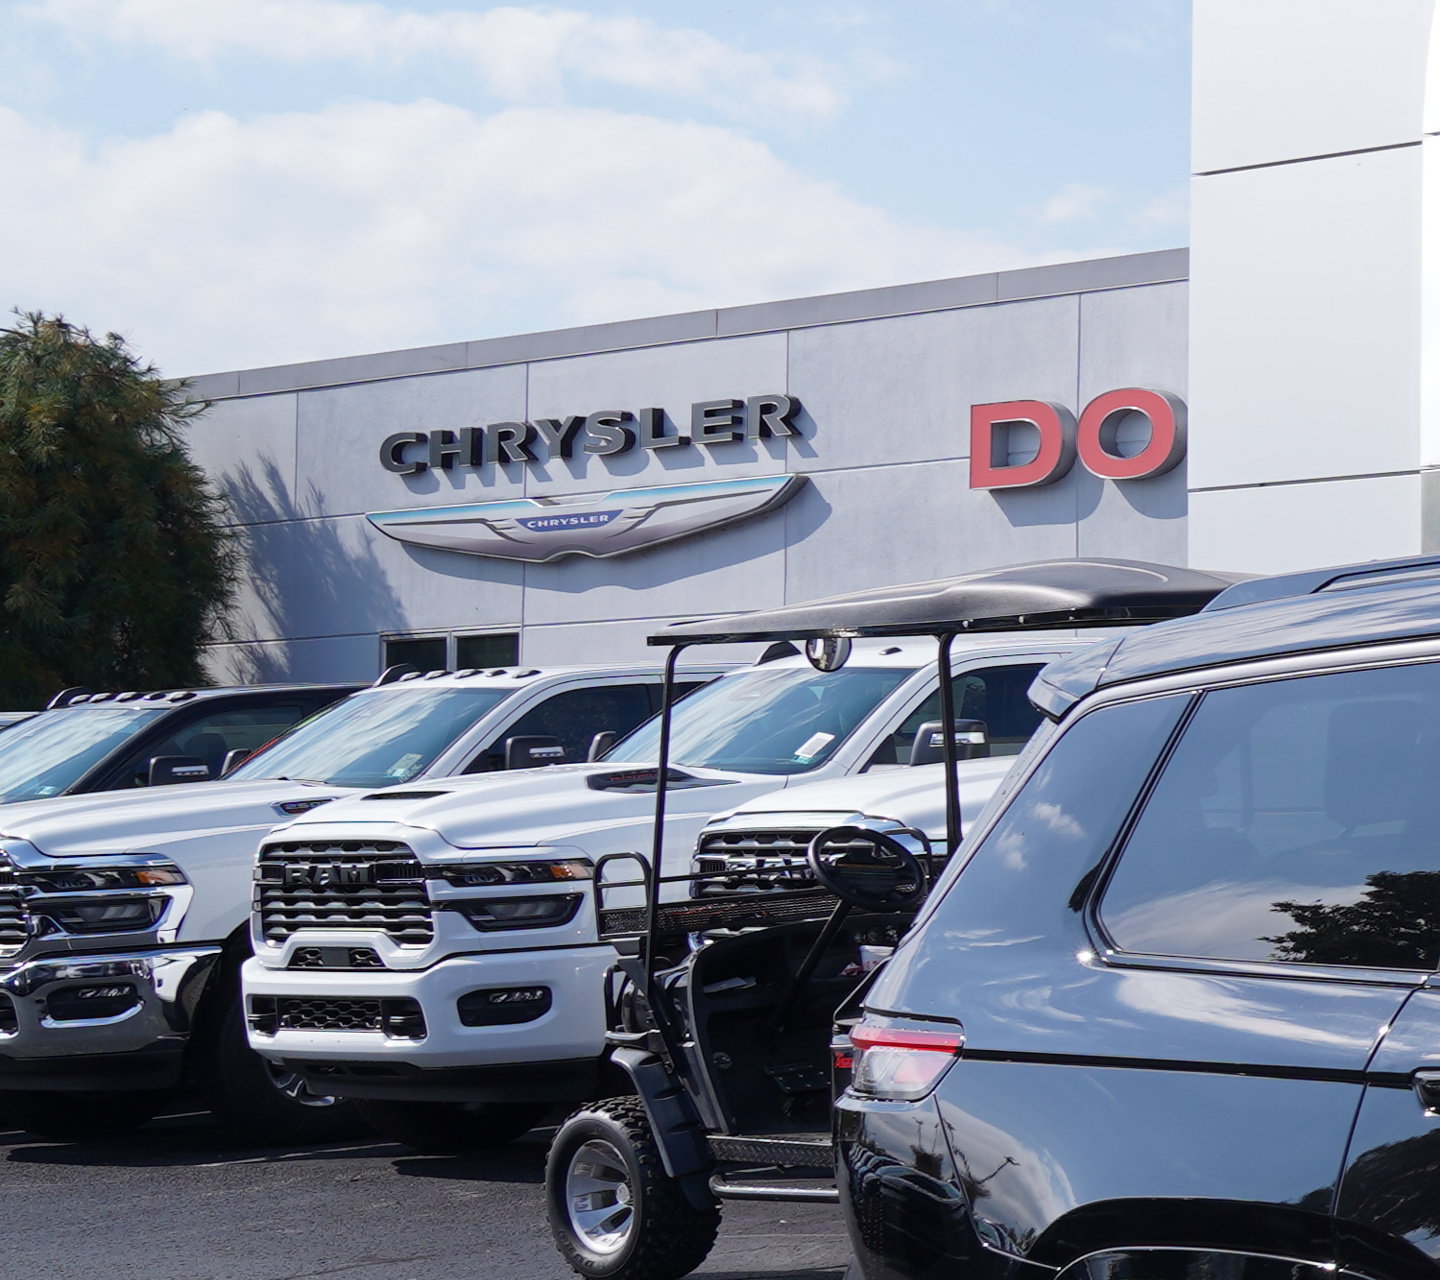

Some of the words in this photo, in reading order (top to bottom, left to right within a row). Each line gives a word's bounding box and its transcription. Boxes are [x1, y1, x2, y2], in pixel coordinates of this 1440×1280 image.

[379, 392, 803, 476] CHRYSLER
[526, 513, 611, 529] CHRYSLER
[285, 863, 372, 886] RAM
